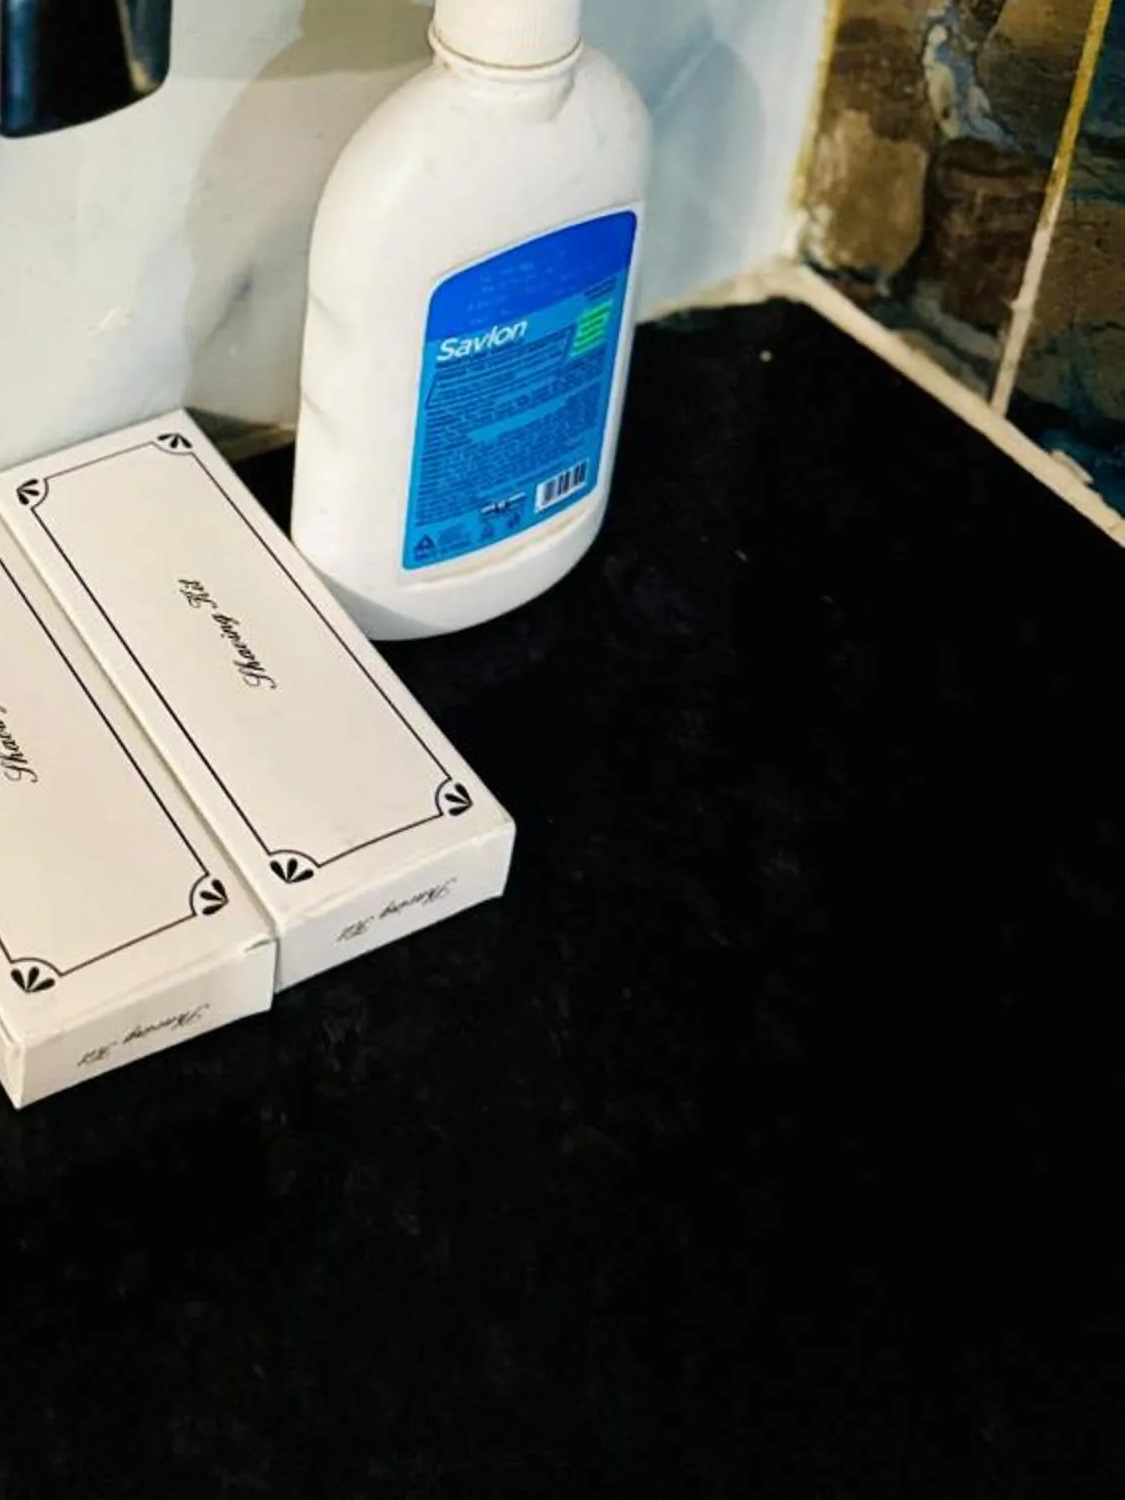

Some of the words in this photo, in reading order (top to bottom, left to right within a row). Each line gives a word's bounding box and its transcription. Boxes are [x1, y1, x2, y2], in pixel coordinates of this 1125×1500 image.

[436, 319, 529, 362] Savlon
[178, 578, 218, 609] Kit
[211, 612, 277, 690] Shaving
